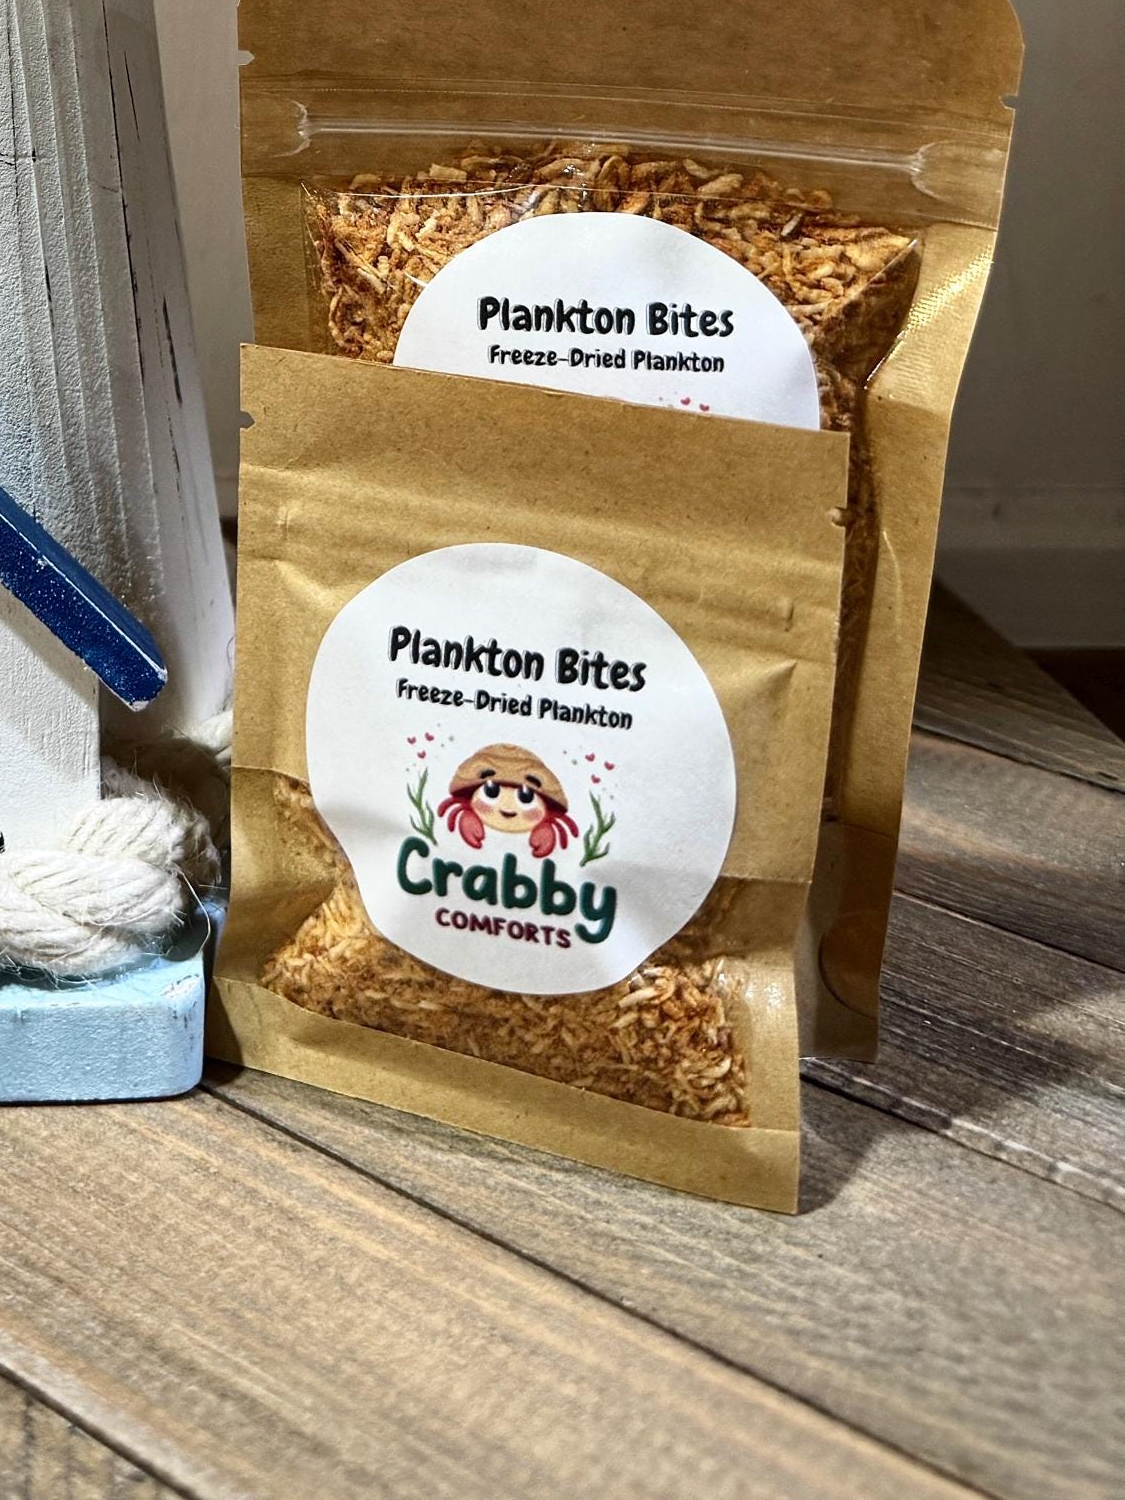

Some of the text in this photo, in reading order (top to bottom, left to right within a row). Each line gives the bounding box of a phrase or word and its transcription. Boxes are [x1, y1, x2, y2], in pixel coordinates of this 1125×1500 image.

[478, 295, 734, 338] Plankton Bites
[489, 344, 725, 373] Freeze-Dried Plankton
[389, 625, 647, 693] Plankton Bites
[396, 678, 633, 730] Freeze-Dried Plankton
[396, 836, 618, 944] Crabby
[435, 907, 572, 949] COMFORTS
